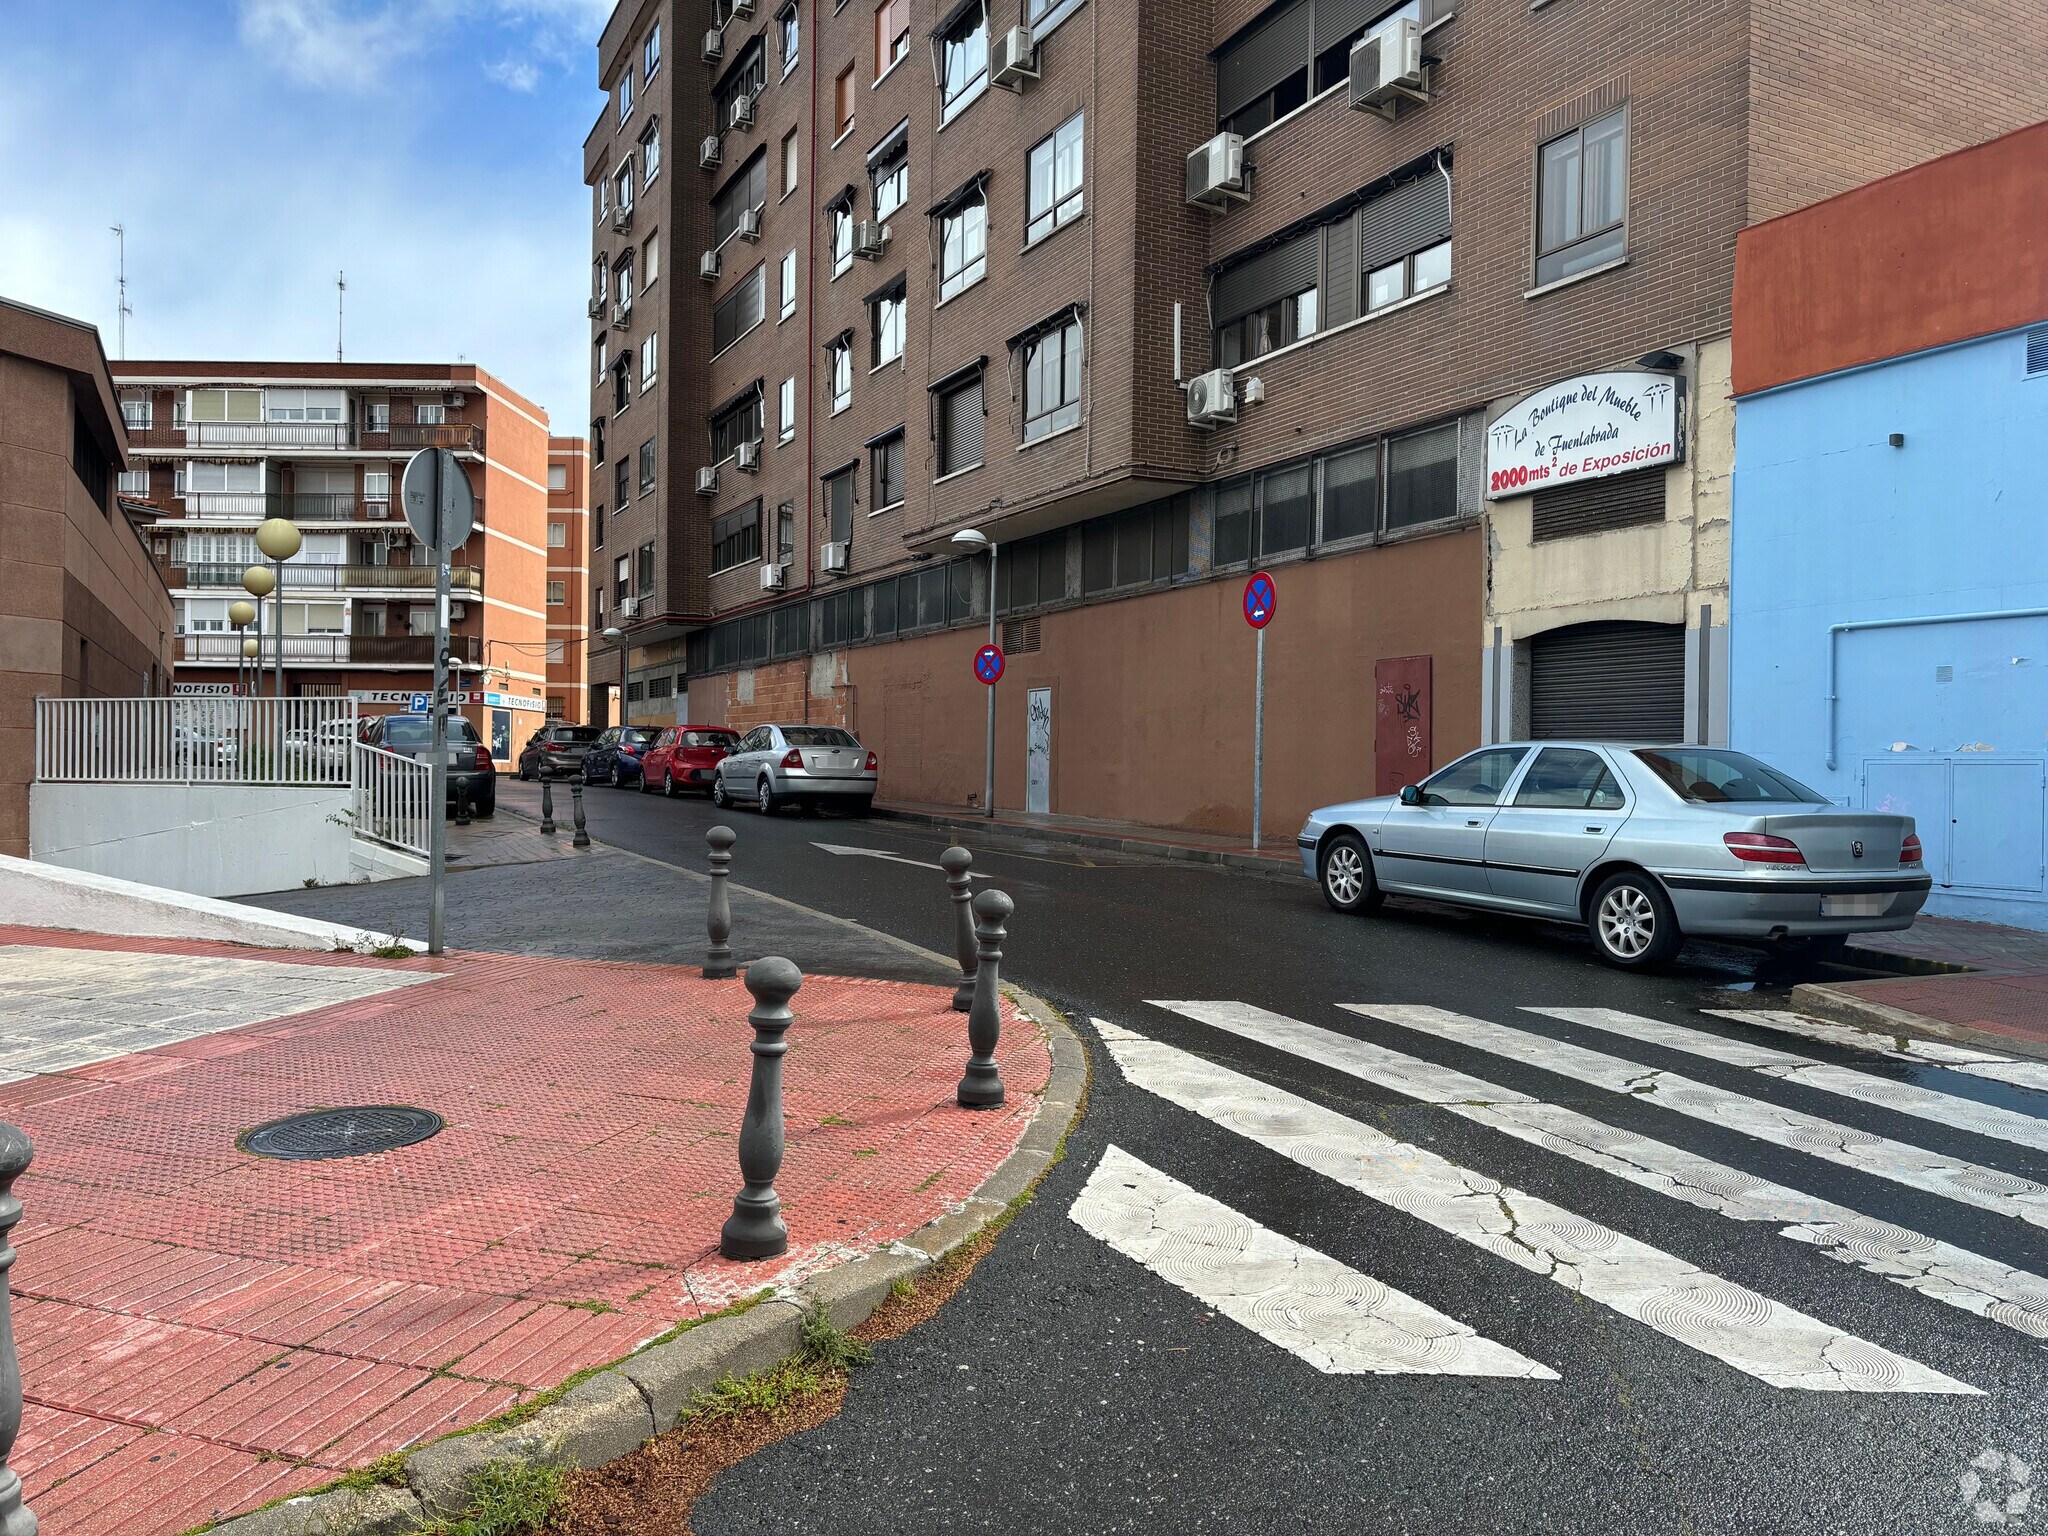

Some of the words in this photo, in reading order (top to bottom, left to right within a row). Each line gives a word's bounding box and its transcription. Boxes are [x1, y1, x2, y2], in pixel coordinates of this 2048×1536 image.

[1514, 427, 1527, 451] La
[1528, 390, 1578, 427] Boutique
[1580, 384, 1599, 402] del
[1598, 386, 1642, 422] Mueble
[1534, 440, 1546, 457] de
[1548, 422, 1619, 455] Fuenlabrada
[1558, 462, 1578, 478] de
[1582, 442, 1671, 472] Exposición
[414, 698, 425, 710] P
[508, 697, 541, 709] TECNOFISIO
